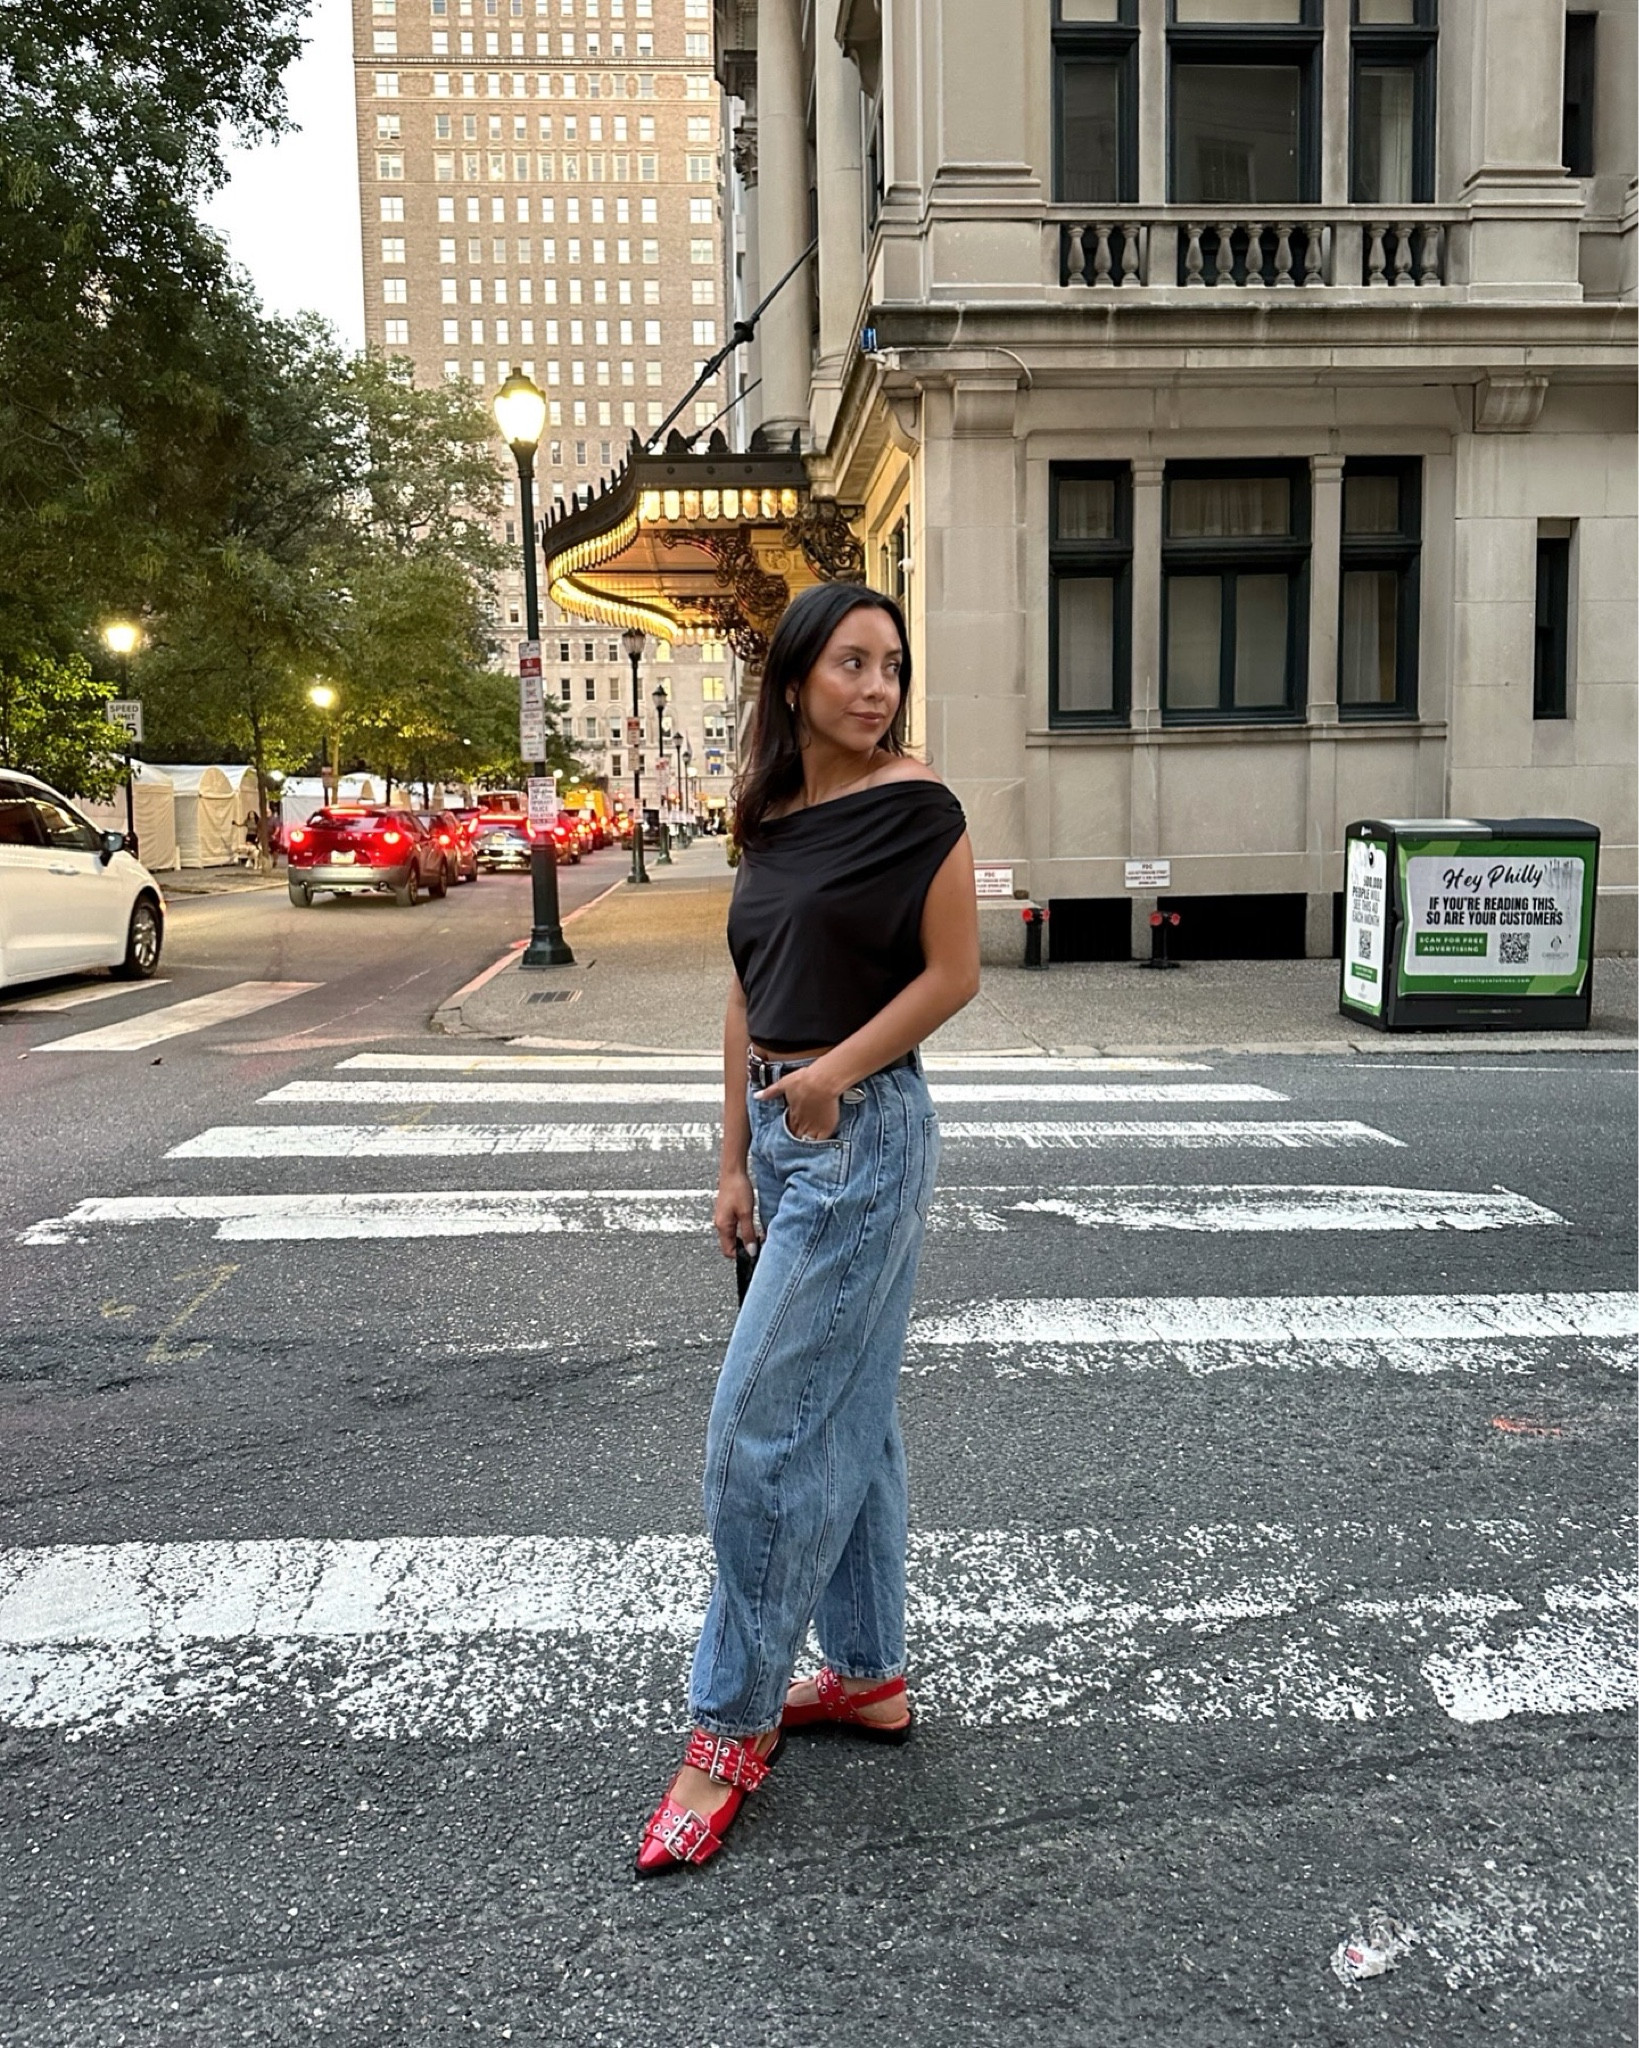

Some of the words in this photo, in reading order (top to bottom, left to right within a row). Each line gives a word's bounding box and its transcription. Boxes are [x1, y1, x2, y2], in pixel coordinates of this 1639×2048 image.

[109, 704, 139, 712] SPEED
[1442, 867, 1483, 893] Hey
[1487, 864, 1543, 888] Philly
[1352, 886, 1370, 899] PEOPLE
[1429, 896, 1440, 910] IF
[1442, 896, 1481, 910] YOU'RE
[1484, 896, 1529, 910] READING
[1532, 897, 1558, 912] THIS,
[1426, 911, 1441, 925] SO
[1444, 911, 1465, 925] ARE
[1468, 911, 1497, 925] YOUR
[1500, 911, 1563, 925] CUSTOMERS
